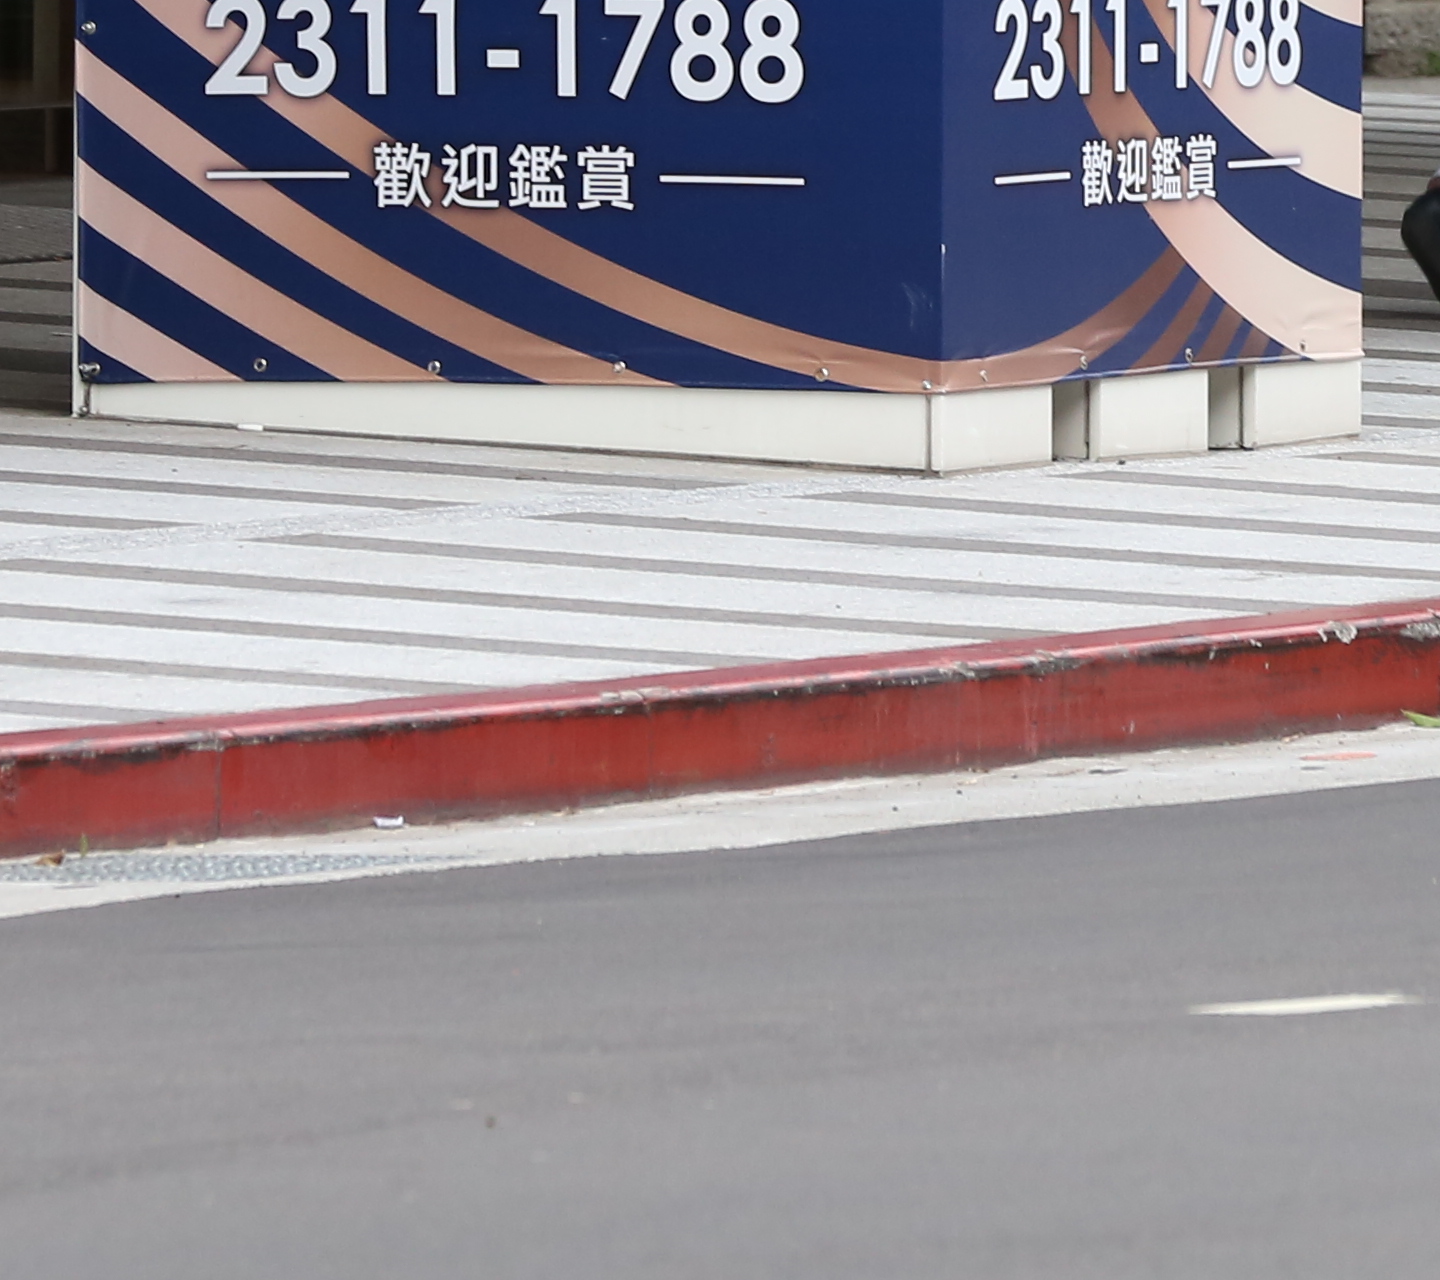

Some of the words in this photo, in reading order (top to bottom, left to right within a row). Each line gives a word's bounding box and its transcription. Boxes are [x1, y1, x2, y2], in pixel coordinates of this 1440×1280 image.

[373, 140, 637, 211] 歡迎鑑賞
[1080, 132, 1222, 210] 歡迎鑑賞
